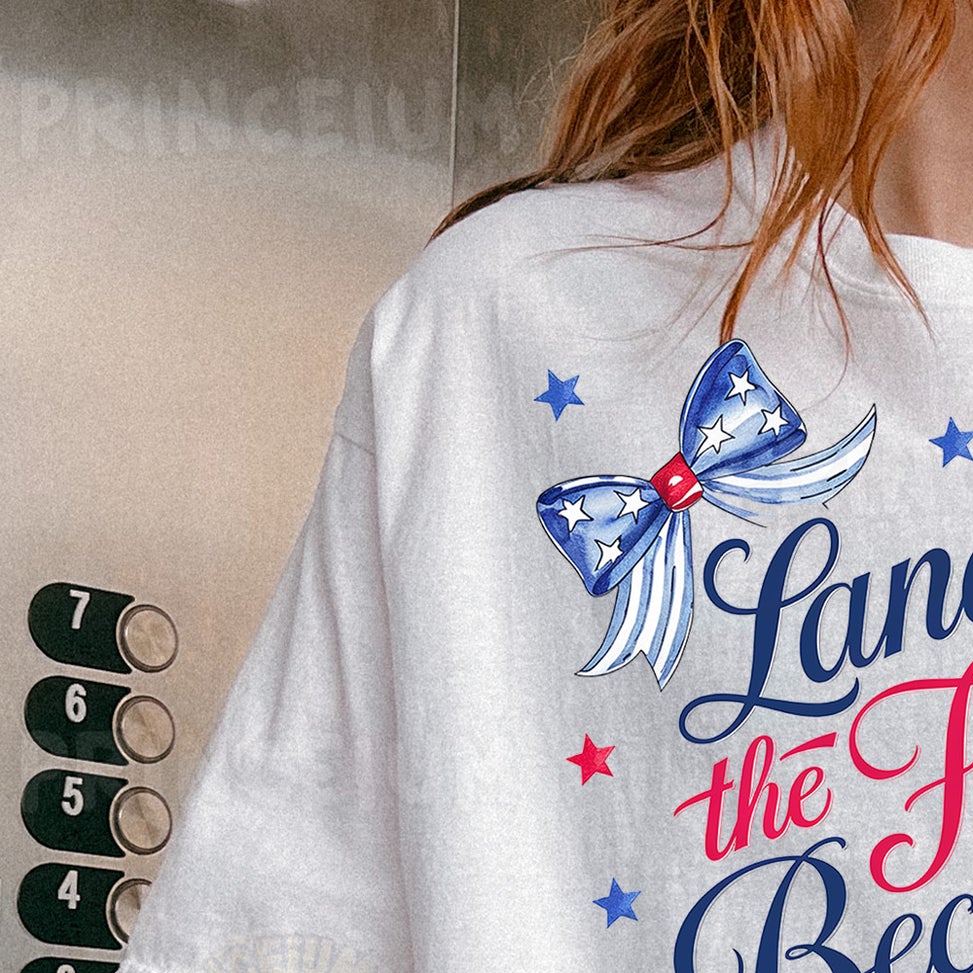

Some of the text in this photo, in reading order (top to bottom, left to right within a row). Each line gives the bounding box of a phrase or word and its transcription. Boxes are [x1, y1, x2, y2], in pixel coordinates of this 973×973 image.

[68, 589, 91, 630] 7
[64, 683, 87, 723] 6
[61, 775, 85, 816] 5
[673, 735, 833, 862] the
[57, 870, 81, 910] 4
